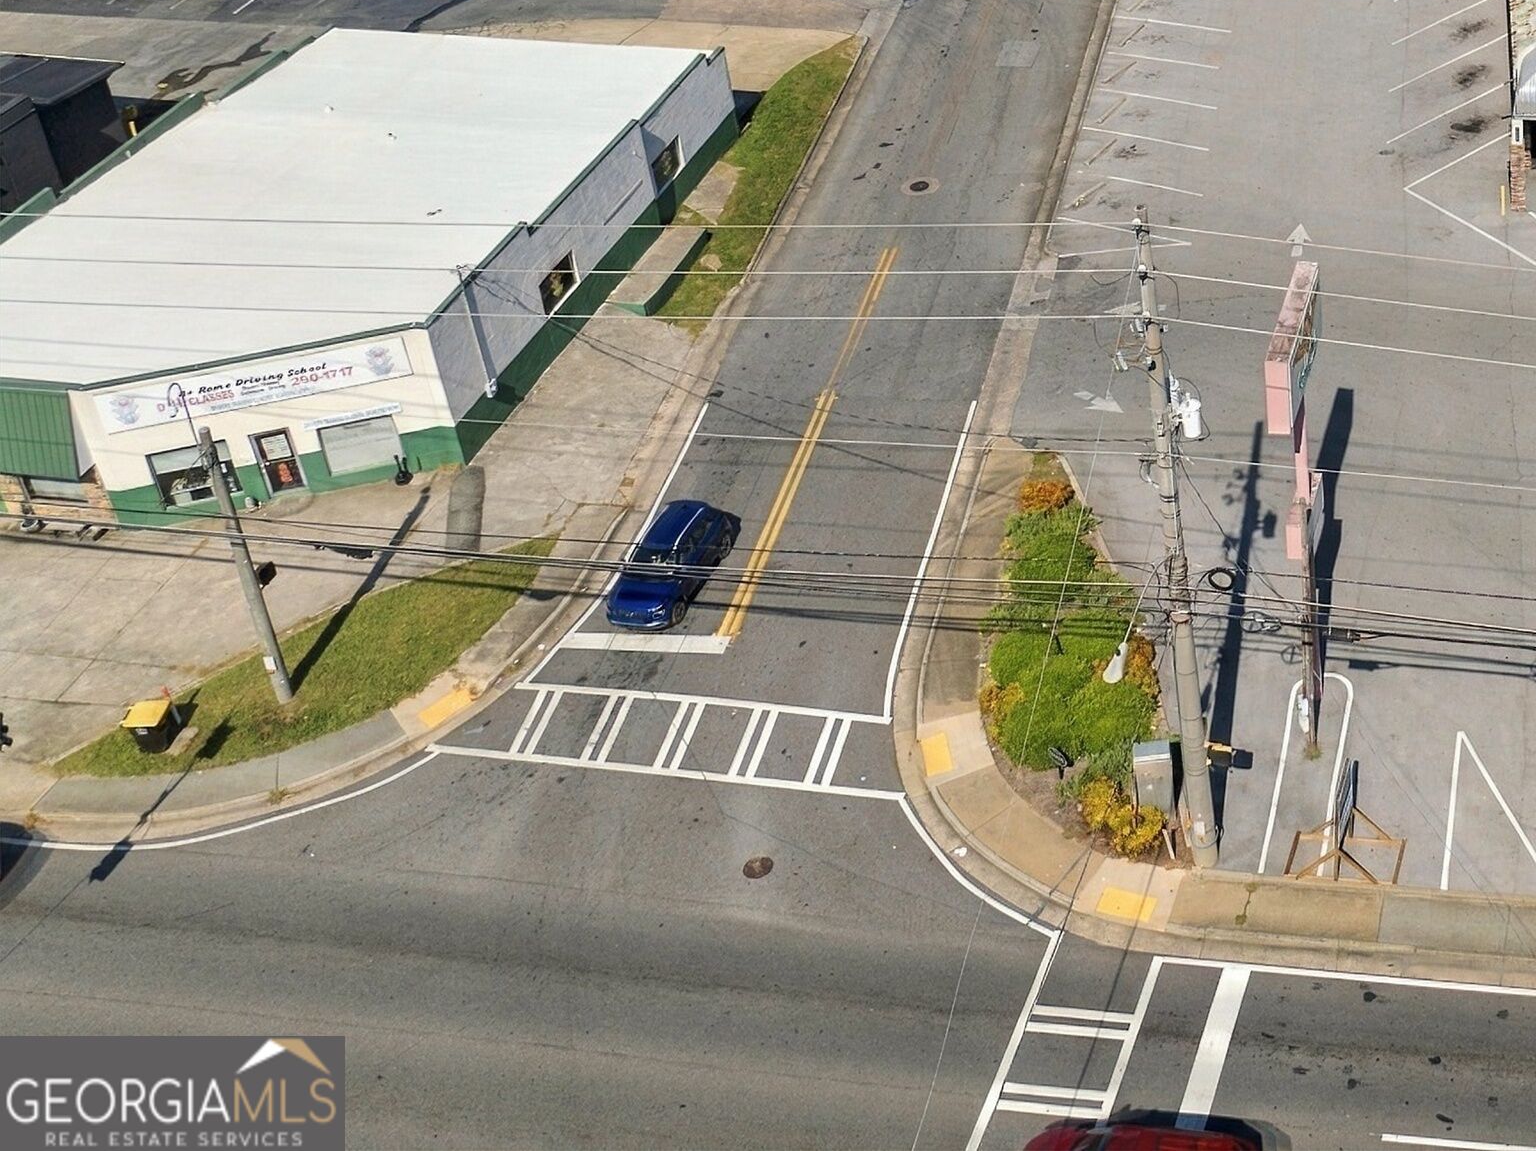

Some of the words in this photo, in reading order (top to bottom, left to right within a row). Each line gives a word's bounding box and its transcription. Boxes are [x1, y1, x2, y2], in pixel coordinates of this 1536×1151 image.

[198, 382, 231, 395] Rome
[235, 373, 283, 387] Driving
[287, 362, 327, 378] School
[189, 389, 235, 406] CLASSES
